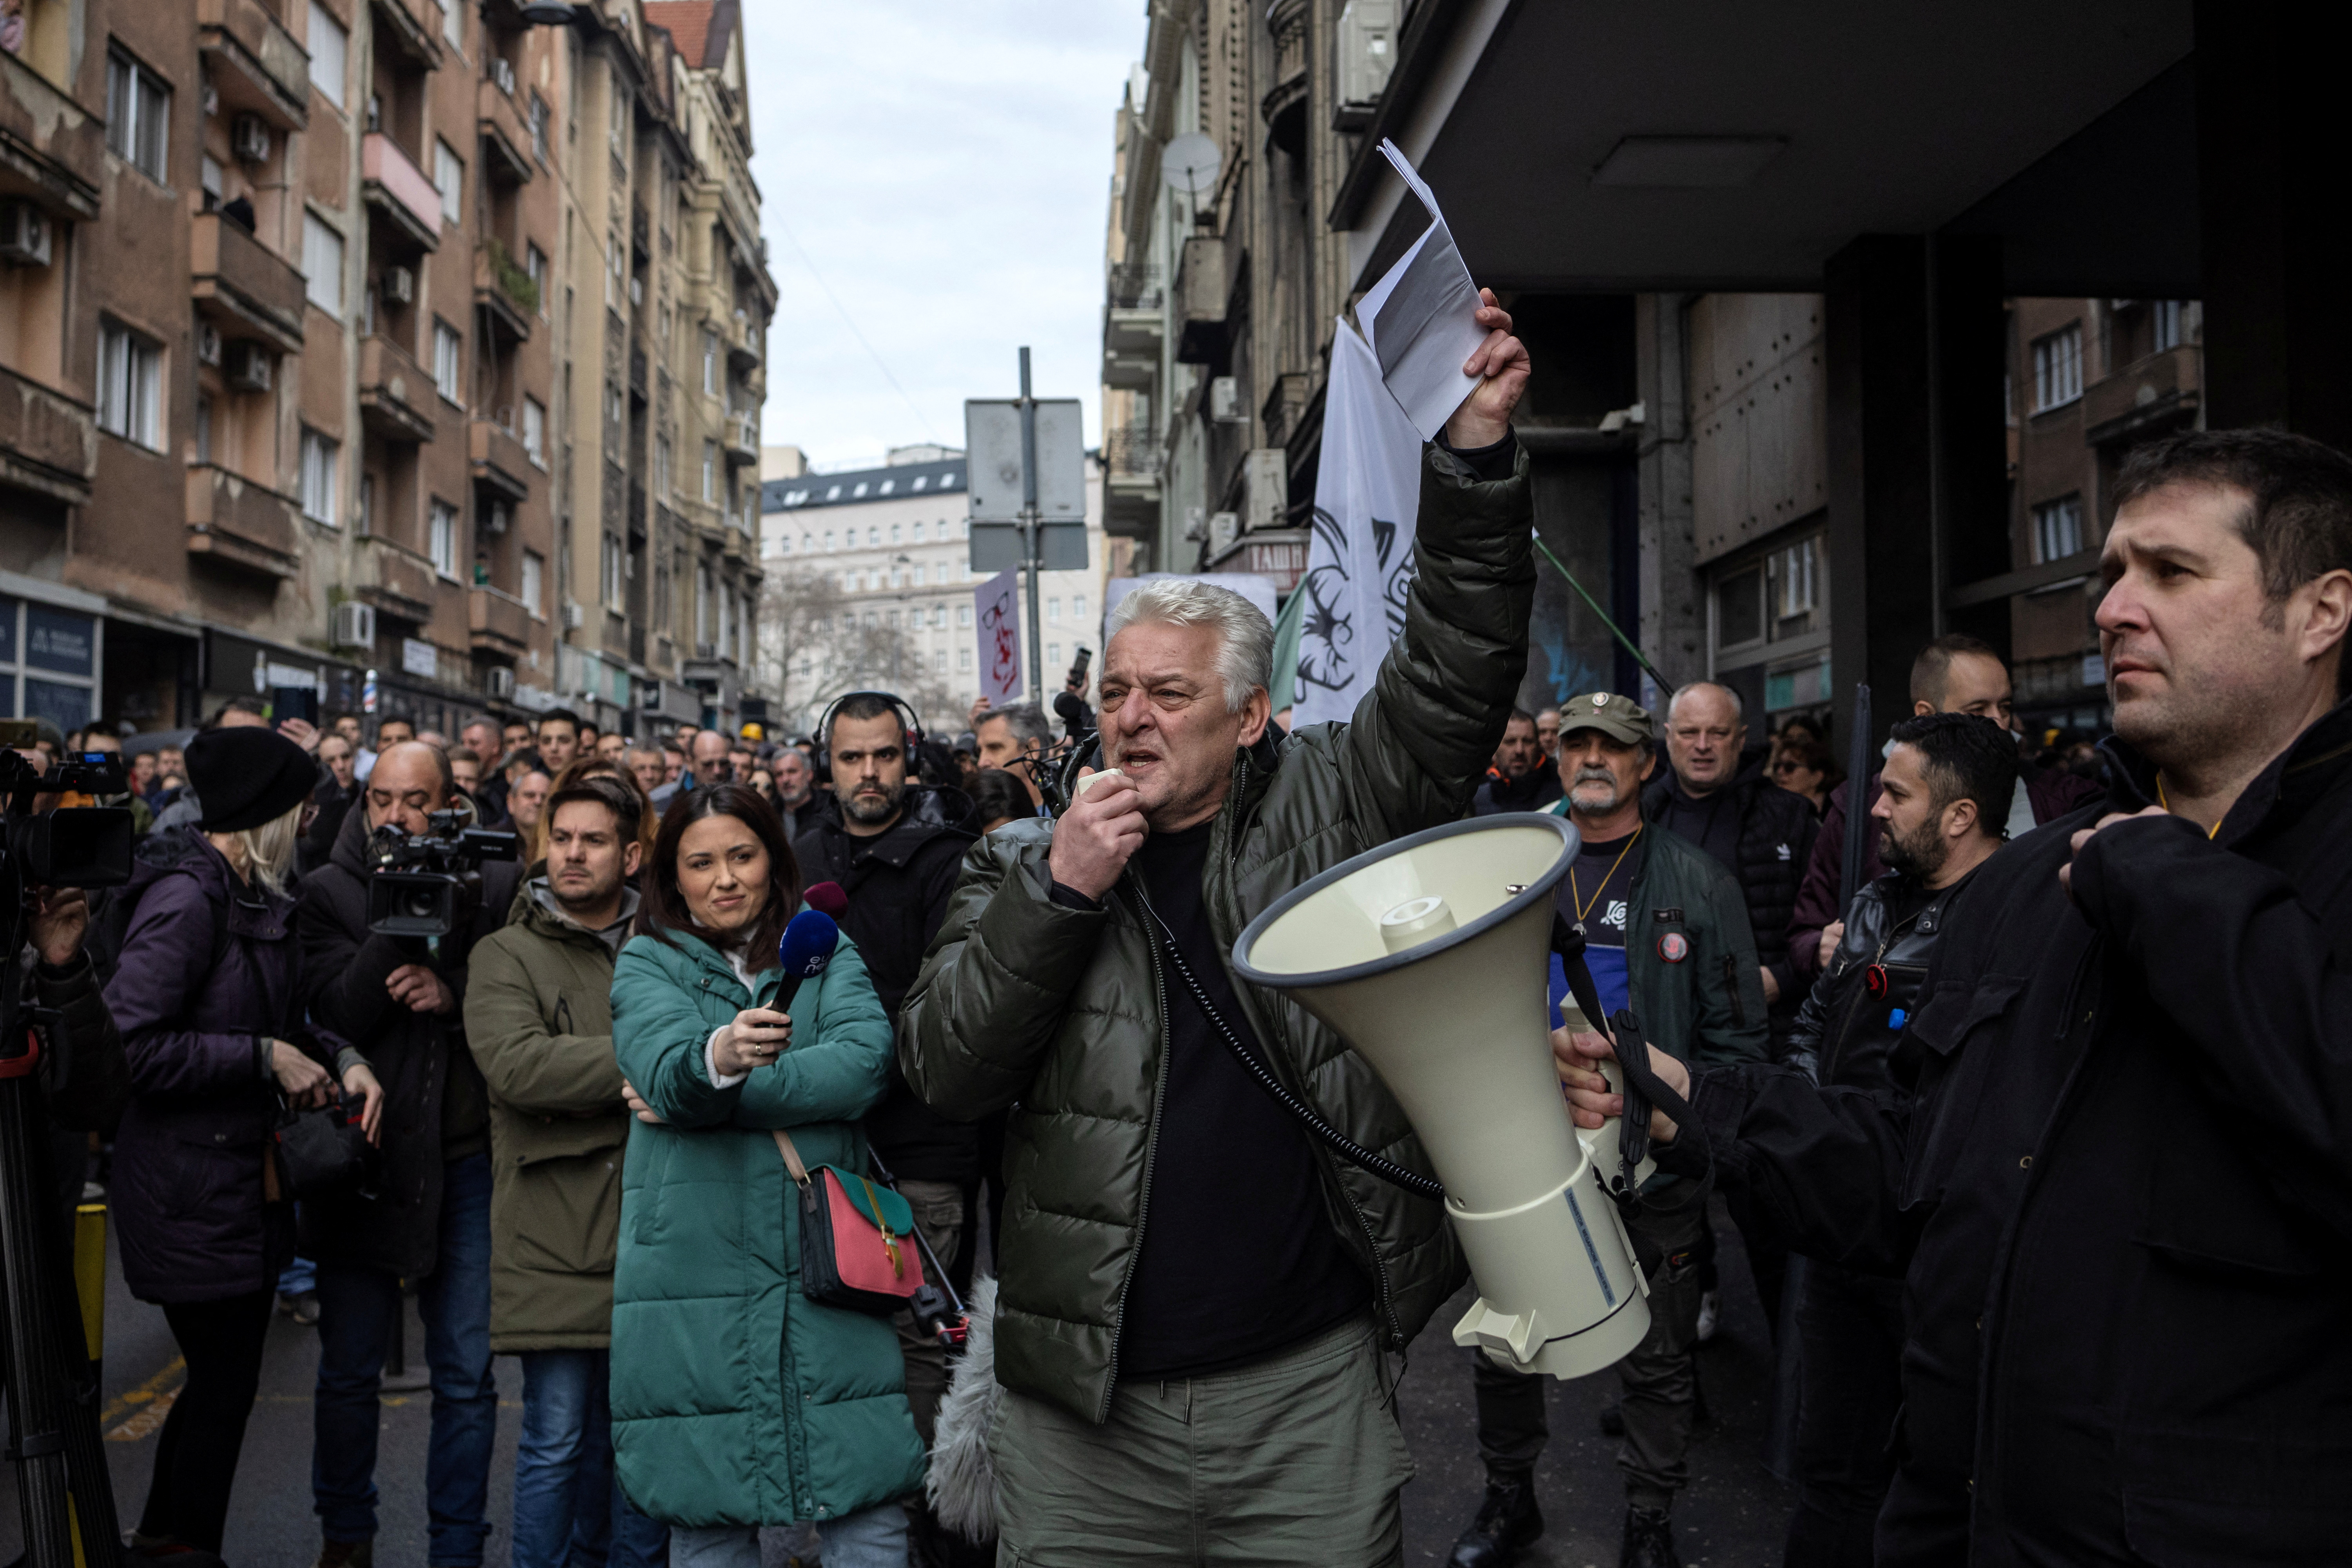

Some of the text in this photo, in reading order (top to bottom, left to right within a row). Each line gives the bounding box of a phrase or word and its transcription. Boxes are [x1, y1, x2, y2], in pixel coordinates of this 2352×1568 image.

[1251, 544, 1308, 571] ТАШН
[1568, 1192, 1584, 1227] TRANSISTOR
[1583, 1229, 1599, 1263] MEGAPHONE
